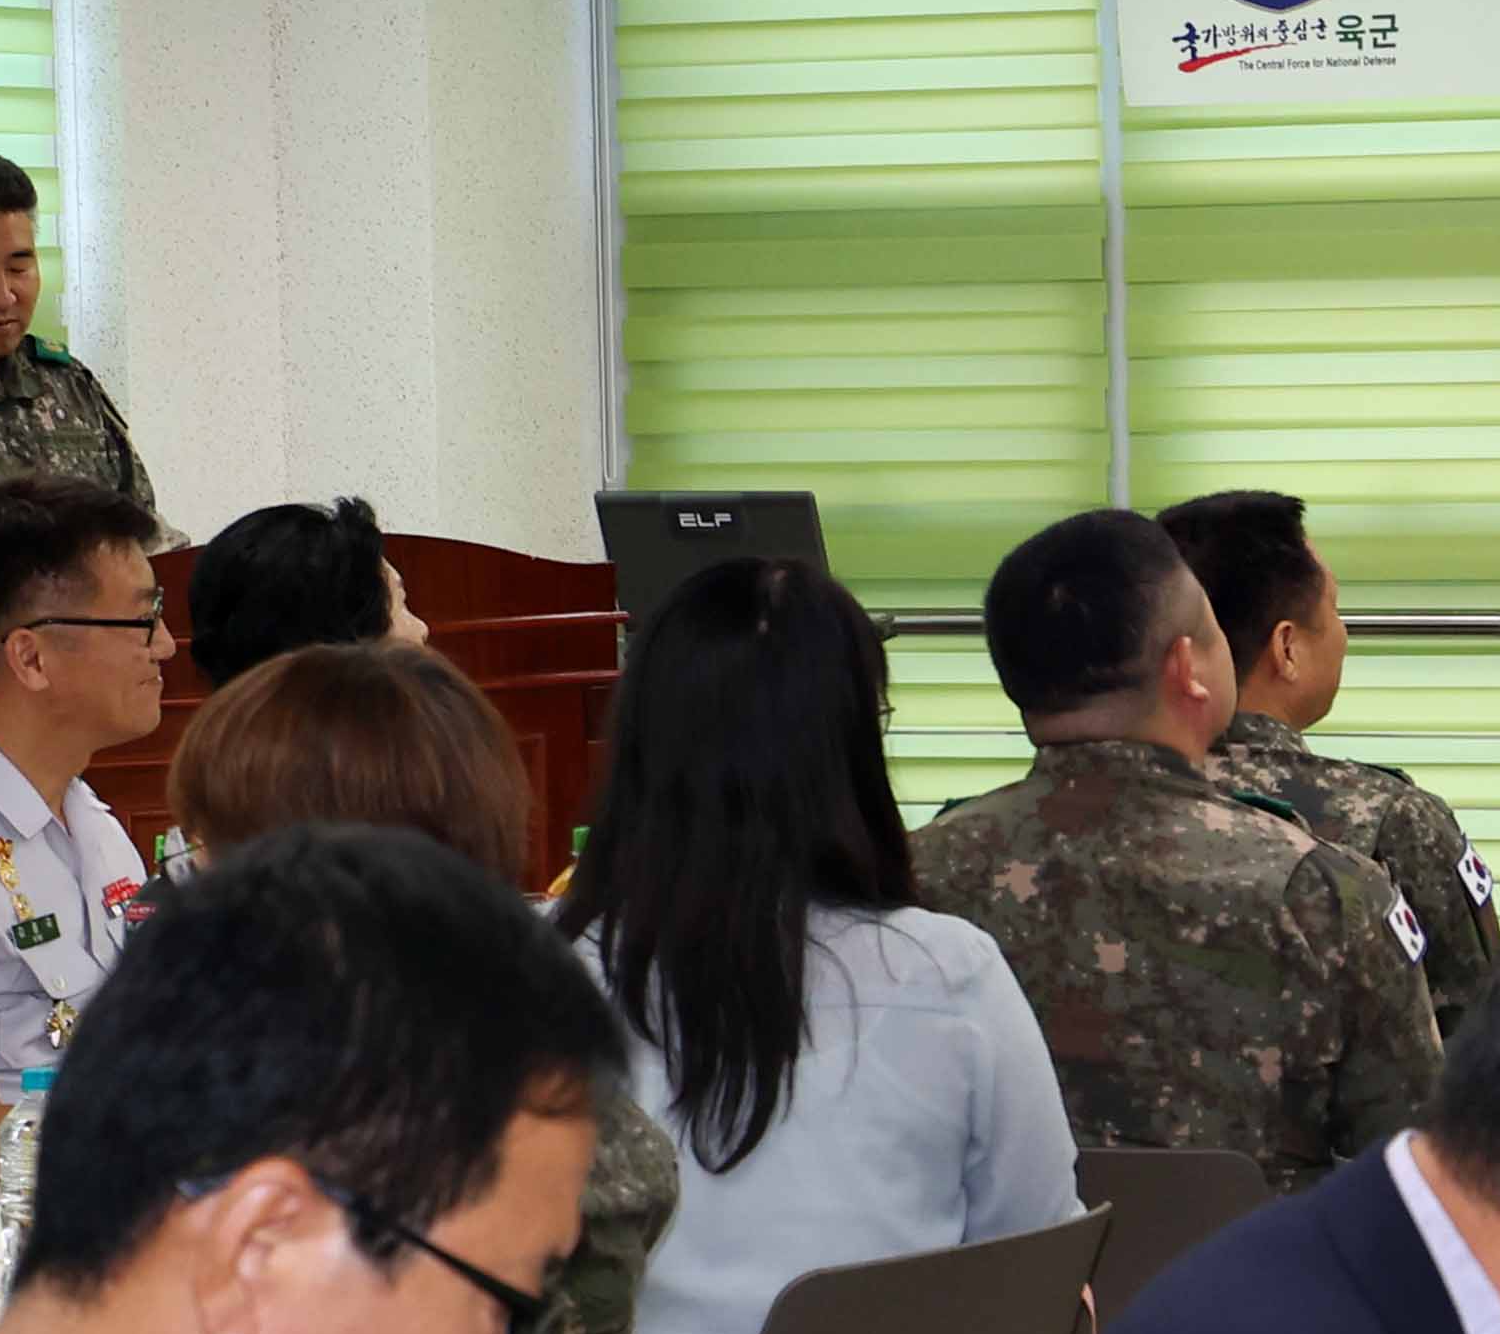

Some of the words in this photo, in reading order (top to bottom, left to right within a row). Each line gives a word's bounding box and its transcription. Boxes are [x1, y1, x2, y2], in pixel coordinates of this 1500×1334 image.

[1335, 14, 1399, 50] 육군
[1239, 59, 1253, 70] The
[1255, 58, 1285, 70] Central
[1287, 58, 1310, 69] Force
[1312, 57, 1324, 68] for
[1326, 56, 1361, 68] National
[1363, 54, 1397, 66] Defense
